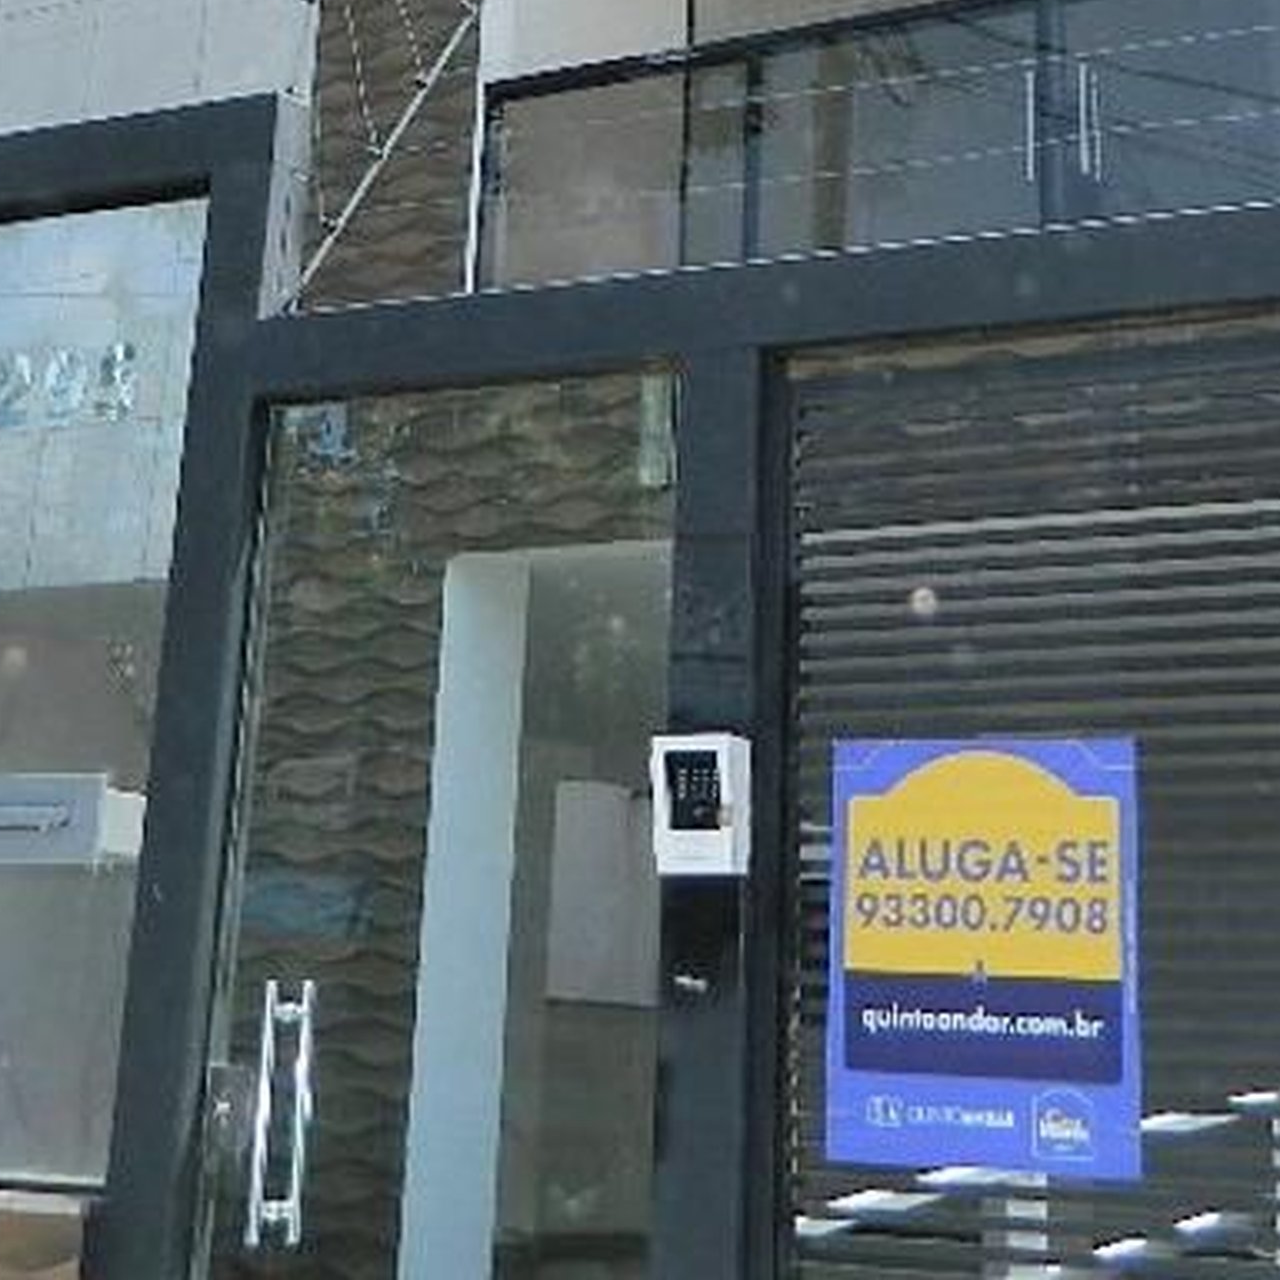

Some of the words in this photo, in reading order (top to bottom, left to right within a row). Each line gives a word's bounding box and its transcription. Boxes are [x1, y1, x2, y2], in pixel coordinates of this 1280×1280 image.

[858, 837, 1109, 884] ALUGA-SE
[855, 892, 1109, 935] 93300.7908
[861, 1001, 1105, 1038] quintoandar.com.br
